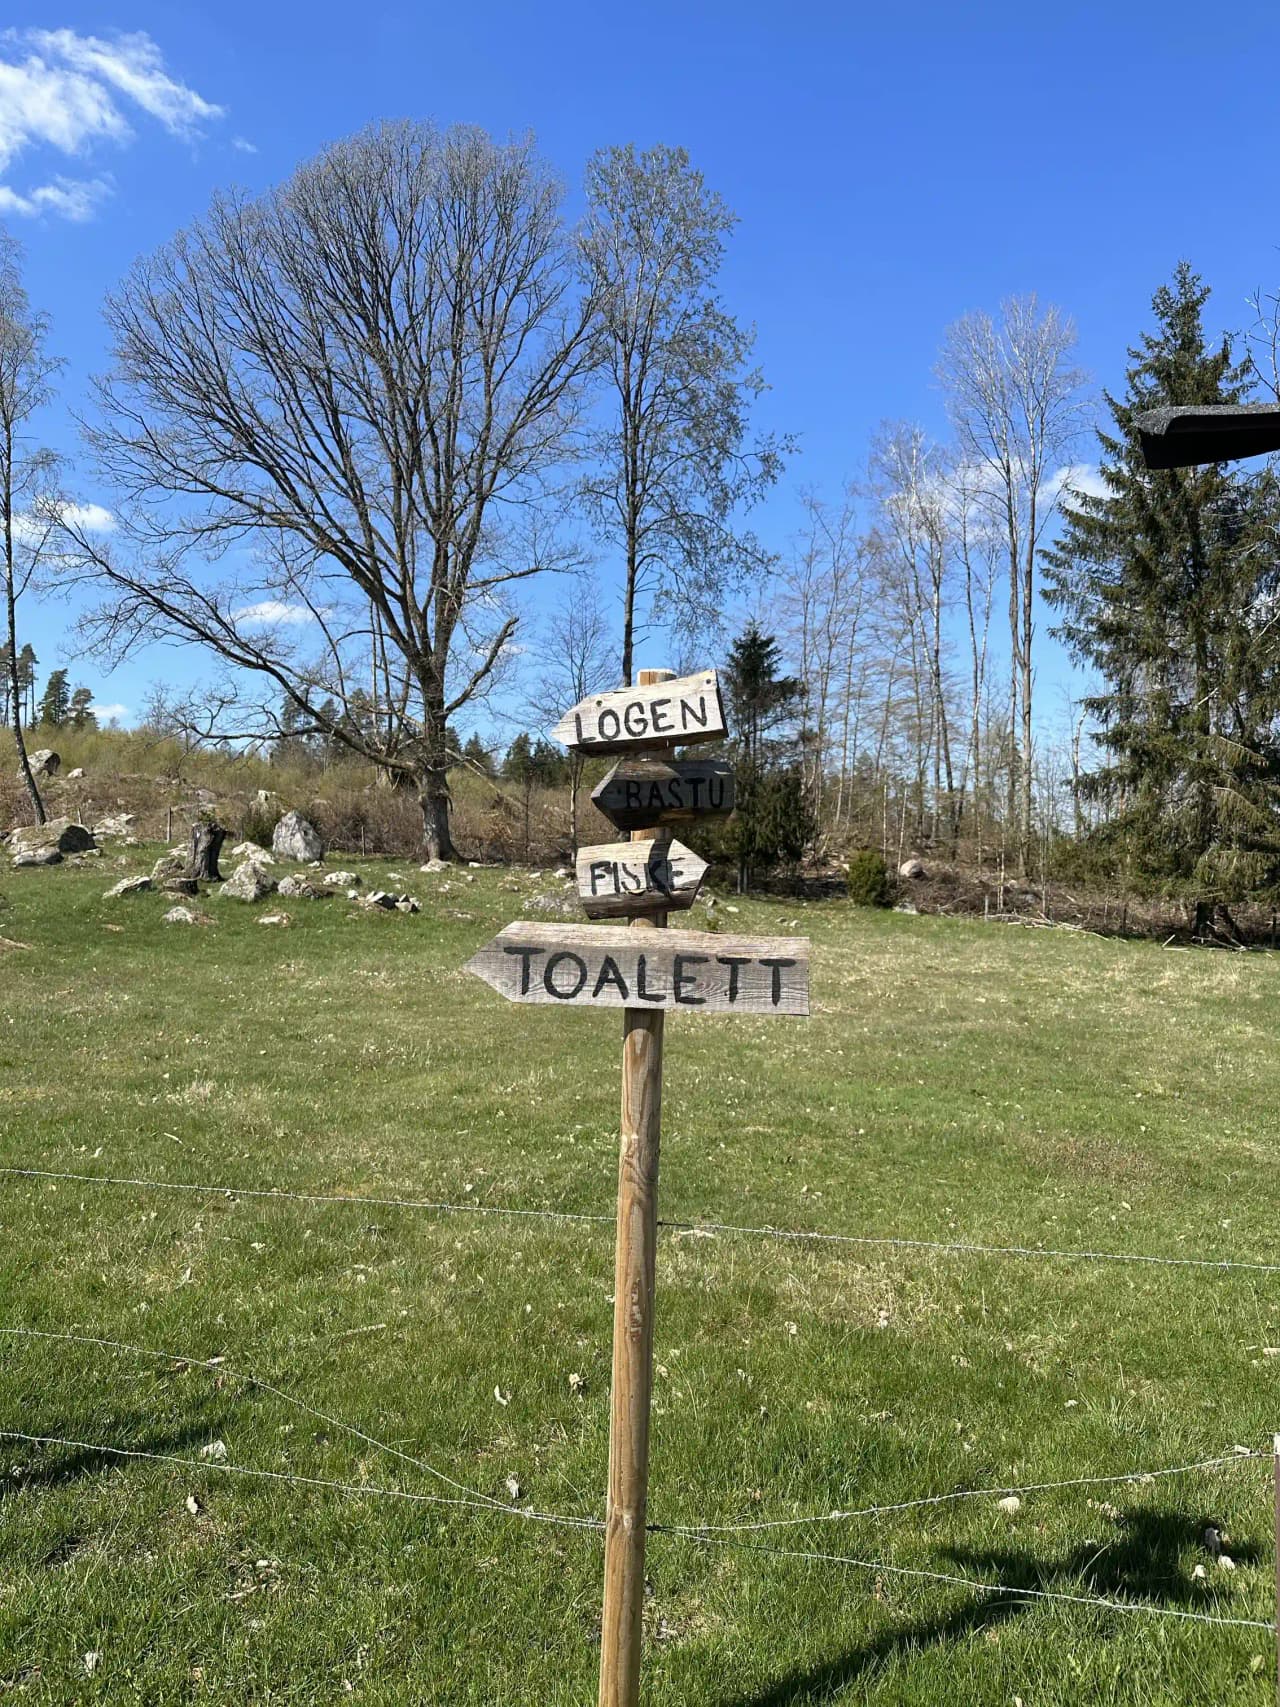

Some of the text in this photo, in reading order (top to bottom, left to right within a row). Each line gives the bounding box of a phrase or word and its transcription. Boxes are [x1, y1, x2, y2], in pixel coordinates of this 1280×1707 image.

[574, 696, 708, 744] LOGEN
[625, 777, 724, 809] BASTU
[590, 857, 687, 897] FISKE
[503, 946, 797, 1006] TOALETT
